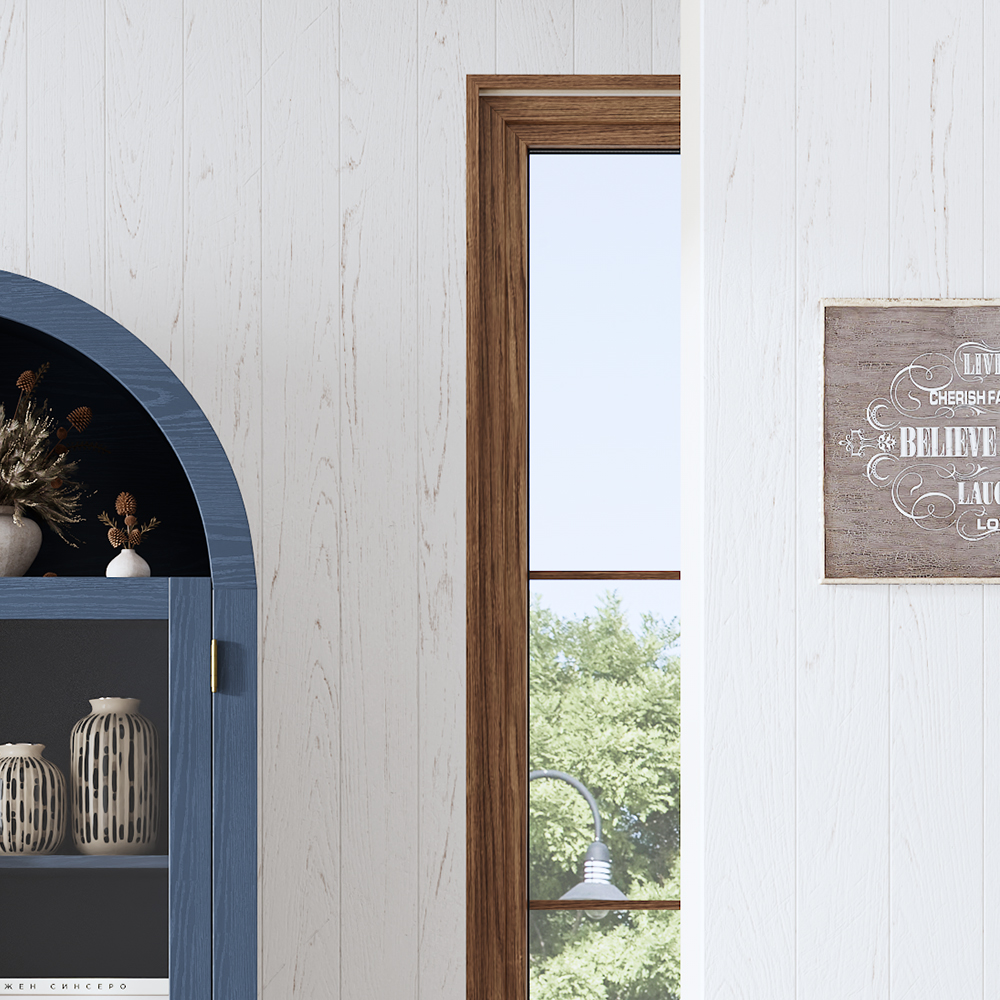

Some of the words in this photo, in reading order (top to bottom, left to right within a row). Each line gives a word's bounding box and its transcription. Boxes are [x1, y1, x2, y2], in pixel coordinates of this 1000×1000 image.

[930, 390, 986, 405] CHERISH
[900, 426, 996, 458] BELIEVE
[977, 518, 1000, 530] LO
